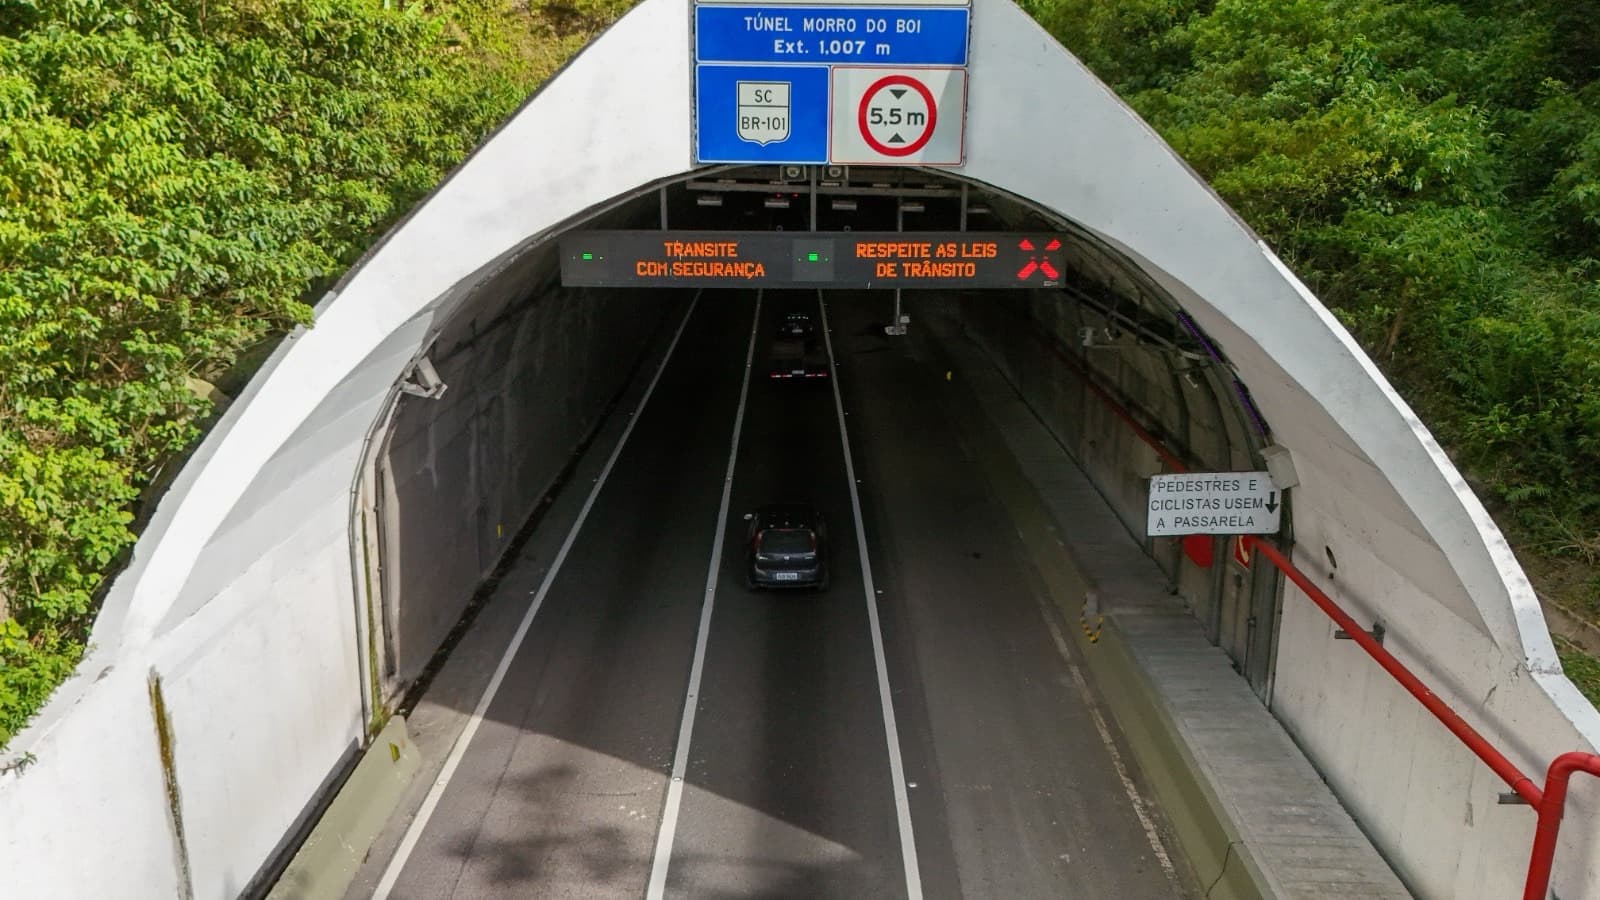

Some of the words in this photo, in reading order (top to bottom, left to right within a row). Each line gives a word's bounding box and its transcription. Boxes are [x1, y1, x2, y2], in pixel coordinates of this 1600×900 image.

[744, 12, 793, 32] TÚNEL
[803, 18, 856, 33] MORRO
[866, 19, 887, 33] DO
[896, 19, 921, 33] BOI
[774, 40, 809, 54] Ext.
[875, 44, 891, 55] m
[754, 89, 773, 103] SC
[741, 116, 786, 131] BR-101
[870, 107, 902, 126] 5,5
[906, 111, 925, 126] m
[664, 242, 738, 257] TRANSITE
[856, 243, 931, 258] RESPEITE
[936, 243, 957, 258] AS
[961, 243, 997, 258] LEIS
[636, 261, 668, 277] COM
[672, 261, 765, 279] SEGURANÇA
[876, 262, 897, 278] DE
[902, 260, 976, 278] TRÂNSITO
[1158, 480, 1240, 493] PEDESTRES
[1248, 479, 1257, 491] E
[1150, 498, 1220, 511] CICLISTAS
[1224, 498, 1263, 509] USEM
[1156, 517, 1166, 529] A
[1174, 516, 1255, 528] PASSARELA
